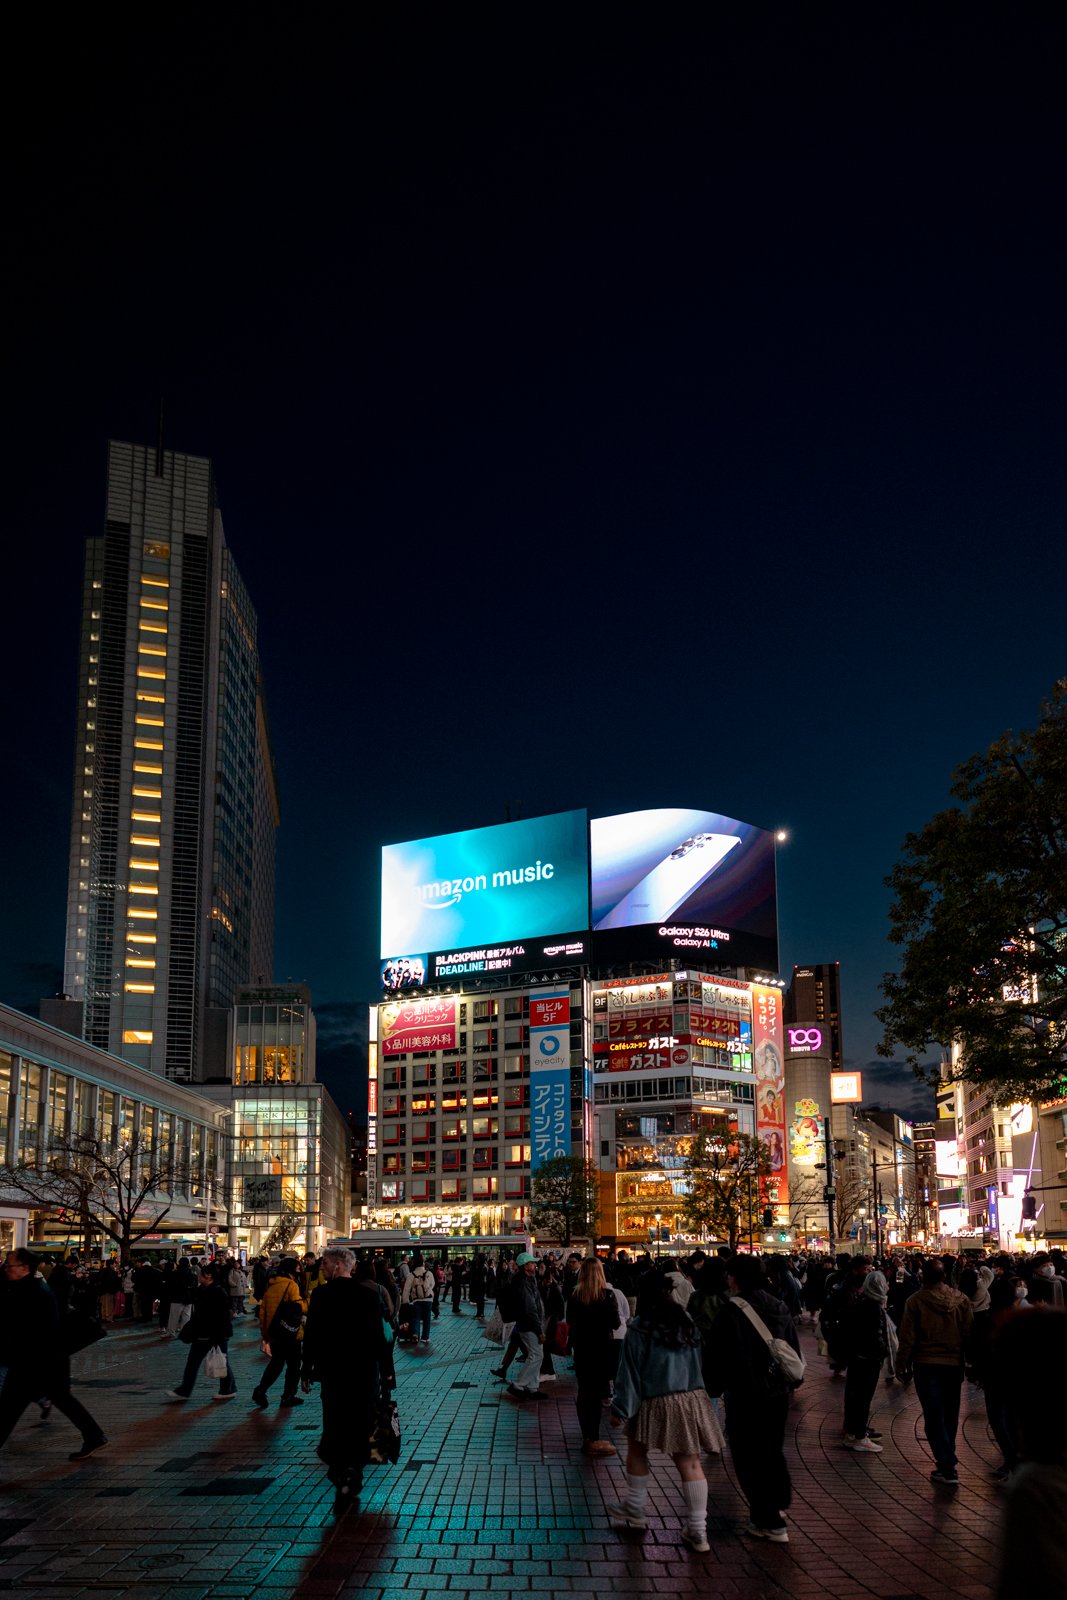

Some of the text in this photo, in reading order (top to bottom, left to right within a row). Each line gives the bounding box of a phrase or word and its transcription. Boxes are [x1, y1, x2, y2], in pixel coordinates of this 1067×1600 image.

[492, 860, 554, 888] music
[659, 927, 730, 940] Galaxy S26 Ultra
[544, 945, 565, 954] amazon
[566, 942, 583, 950] music
[674, 938, 702, 948] Galaxy
[436, 946, 525, 965] BLACKPINK 最新アルバム
[602, 973, 669, 988] しゃぶしゃぶバイキング
[594, 998, 606, 1006] 9F
[630, 988, 668, 1003] しゃぶ葉
[414, 1004, 452, 1015] 品川スキン
[536, 1002, 563, 1012] 当ビル
[414, 1013, 448, 1024] クリニック
[543, 1013, 556, 1022] 5F
[690, 1016, 738, 1033] コンタクト
[392, 1034, 451, 1049] 品川美容外科
[648, 1036, 679, 1049] ガスト
[788, 1029, 822, 1050] 109
[727, 1041, 749, 1053] ガスト
[535, 1056, 564, 1066] eyecity
[595, 1059, 608, 1069] 7F
[630, 1053, 667, 1070] ガスト
[535, 1085, 551, 1160] アイシティ
[554, 1084, 565, 1158] コンタクトの
[409, 1214, 472, 1228] サンドラッグ
